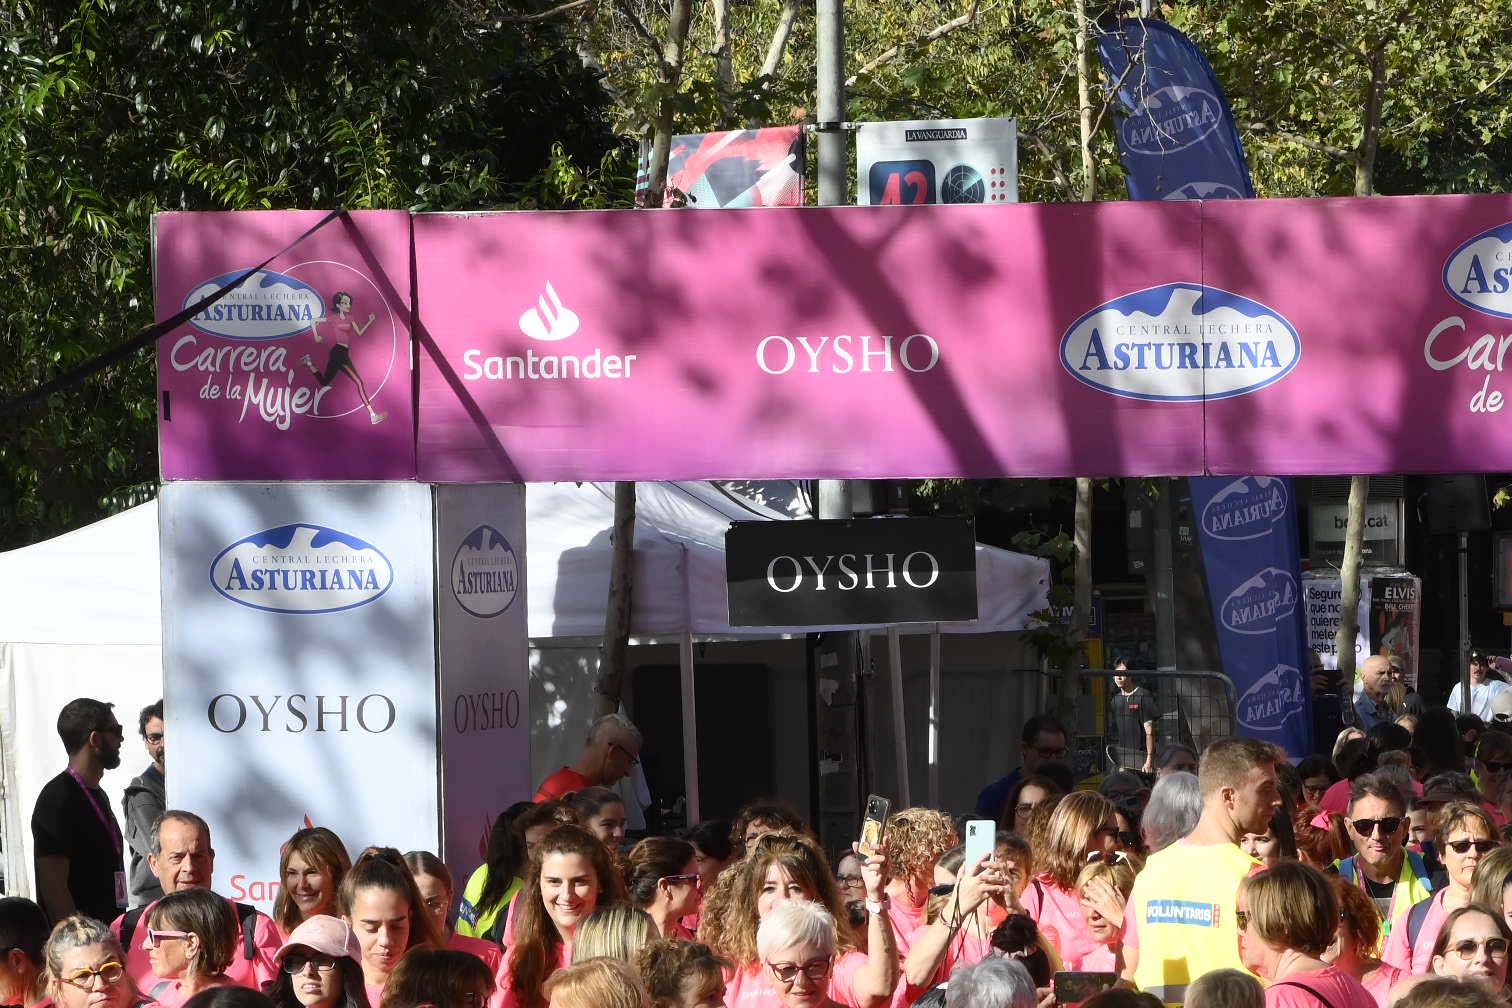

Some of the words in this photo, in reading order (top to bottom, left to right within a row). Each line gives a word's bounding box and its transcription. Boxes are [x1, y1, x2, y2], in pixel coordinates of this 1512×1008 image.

[916, 129, 967, 140] VANGUARDIA
[193, 300, 313, 322] ASTURIANA
[1116, 323, 1192, 335] CENTRAL
[1199, 322, 1273, 335] LECHERA
[170, 335, 287, 373] Carrera
[463, 349, 637, 380] Santander
[755, 334, 940, 375] OYSHO
[1079, 328, 1282, 372] ASTURIANA
[199, 379, 221, 402] de
[225, 377, 241, 401] la
[239, 372, 331, 431] Mujer
[1469, 374, 1503, 413] de
[224, 557, 380, 591] ASTURIANA
[252, 555, 311, 564] CENTRAL
[316, 554, 375, 564] LECHERA
[766, 550, 940, 593] OYSHO
[456, 560, 516, 595] ASTURIANA
[1385, 587, 1416, 599] ELVIS
[1310, 604, 1329, 616] que
[1312, 643, 1331, 653] este
[207, 693, 396, 734] OYSHO
[454, 689, 520, 735] OYSHO
[1147, 904, 1212, 922] VOLUNTARIS
